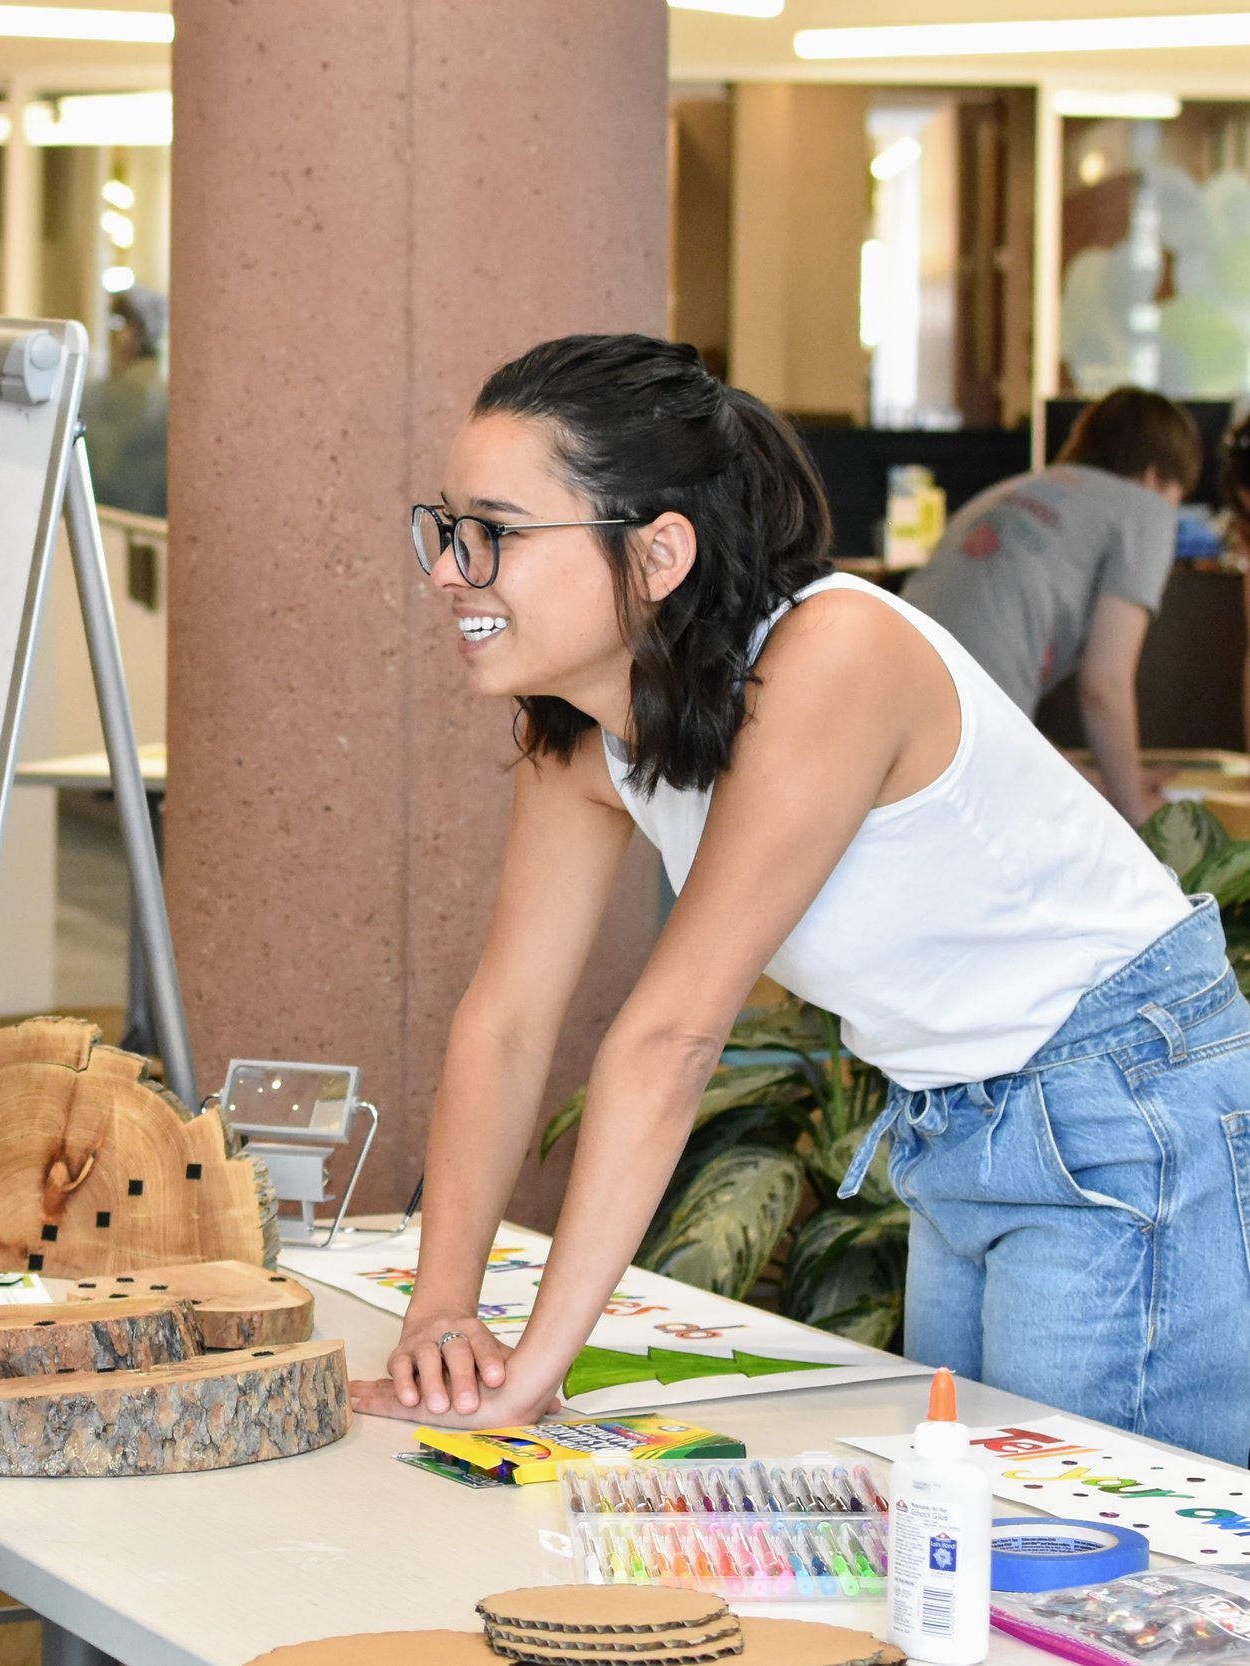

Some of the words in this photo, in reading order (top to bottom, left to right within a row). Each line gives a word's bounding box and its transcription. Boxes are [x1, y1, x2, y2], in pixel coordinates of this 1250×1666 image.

[969, 1427, 1103, 1462] Tell
[1002, 1467, 1196, 1499] your
[1175, 1508, 1250, 1536] ow
